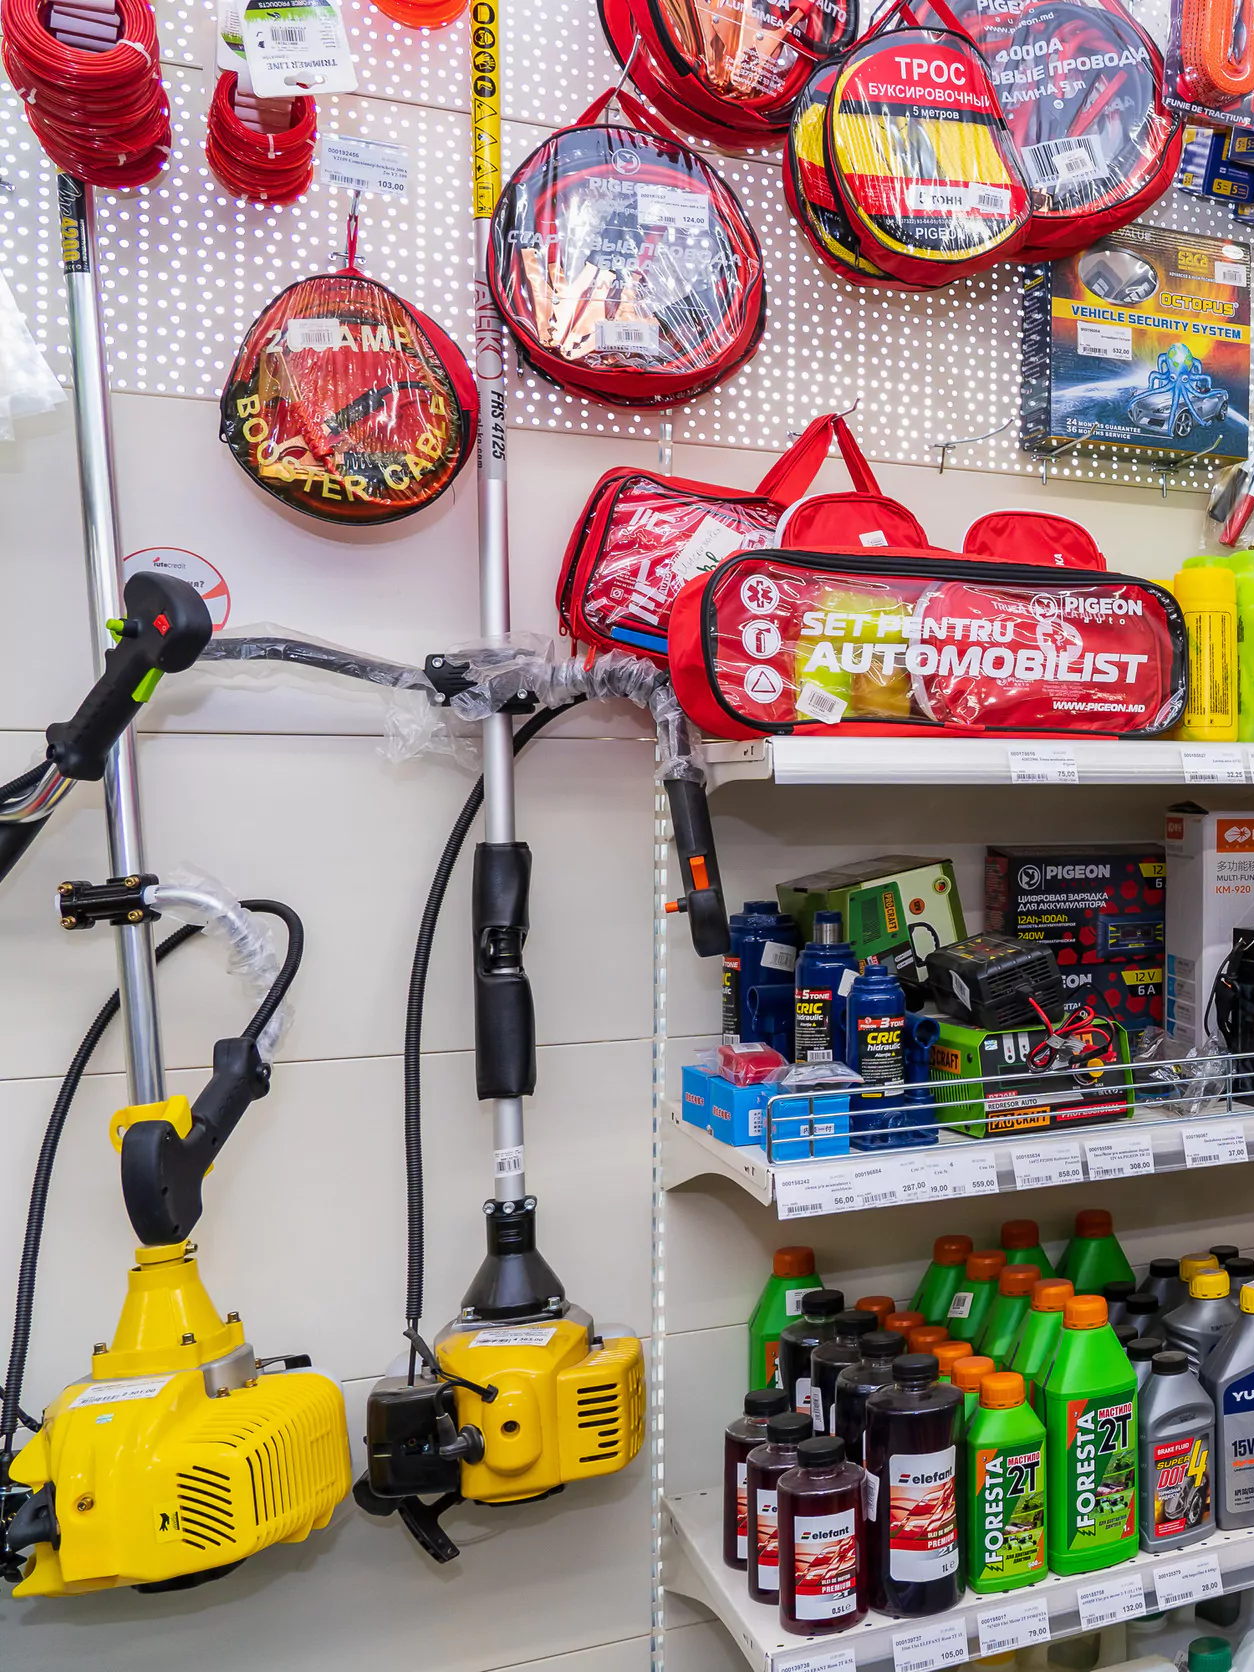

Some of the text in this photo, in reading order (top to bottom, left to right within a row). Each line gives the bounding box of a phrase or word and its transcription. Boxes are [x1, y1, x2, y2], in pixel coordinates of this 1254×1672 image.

[1049, 47, 1150, 77] ПРОВОДА
[894, 57, 967, 86] ТРОС
[1001, 83, 1058, 104] ДЛИНА
[913, 106, 960, 120] 5 метров
[1166, 98, 1188, 111] FUNIE
[1189, 103, 1202, 115] DE
[378, 180, 405, 192] 103.00
[682, 216, 706, 226] 124.00
[62, 216, 81, 262] 4200
[915, 226, 965, 242] PIGEON
[1160, 291, 1235, 318] OCTOPUS
[1072, 305, 1242, 340] VEHICLE SECURITY SYSTEM
[490, 390, 506, 461] FRS 4125
[1066, 417, 1141, 434] 24 MONS GUARANTEE
[1066, 425, 1078, 434] 36
[1105, 431, 1131, 440] SERVICE
[236, 394, 371, 501] BOOSTER
[383, 395, 447, 491] CABLE
[153, 561, 187, 570] iutecredit
[1065, 596, 1143, 616] PIGEON
[800, 611, 1015, 643] SET PENTRU
[803, 641, 1148, 684] AUTOMOBILIST
[1053, 701, 1146, 714] WWW.PIGEON.MD
[1057, 770, 1076, 779] 75,00
[1227, 771, 1243, 779] 32,25
[1046, 864, 1111, 880] PIGEON
[1152, 865, 1163, 876] 12
[1215, 884, 1251, 895] KM-920
[1017, 891, 1109, 904] ЦИФРОВАЯ ЗАРЯДКА
[1017, 900, 1107, 912] ДЛЯ АККУМУЛЯТОРА
[1017, 914, 1068, 925] 12Ah-100Ah
[1017, 932, 1045, 940] 240W
[1134, 972, 1156, 982] 12 V
[801, 989, 831, 1000] 5 TONE
[1137, 985, 1156, 996] 6 A
[796, 1002, 823, 1015] CRIC
[866, 1029, 901, 1045] CRIC
[866, 1042, 902, 1052] hidraulic
[935, 1050, 960, 1070] CRAFT
[987, 1098, 1038, 1111] REDRESOR AUTO
[990, 1108, 1048, 1130] PRO CRAFT
[1228, 1148, 1245, 1157] 37,00
[1058, 1168, 1081, 1178] 858,00
[1129, 1161, 1151, 1171] 308,00
[902, 1181, 926, 1193] 287,00
[972, 1179, 995, 1189] 559,00
[834, 1195, 855, 1206] 56,00
[1098, 1402, 1133, 1420] МАСТИЛО
[1097, 1411, 1132, 1456] 2T
[1157, 1442, 1190, 1456] BRAKE FLUID
[1006, 1451, 1041, 1467] МАСТИЛО
[1157, 1455, 1191, 1471] SUPER
[1157, 1439, 1209, 1490] DOT 4
[911, 1466, 954, 1486] elefant
[1006, 1458, 1041, 1498] 2T
[1076, 1410, 1096, 1534] FORESTA
[984, 1456, 1004, 1564] FORESTA
[811, 1526, 849, 1541] elefant
[927, 1534, 956, 1549] PREMIUM
[938, 1543, 956, 1558] 2T
[821, 1581, 852, 1594] PREMIUM
[1201, 1580, 1219, 1593] 28,00
[832, 1589, 852, 1600] 2T
[1121, 1602, 1144, 1614] 132,00
[1028, 1626, 1047, 1639] 79,00
[940, 1648, 965, 1661] 105,00
